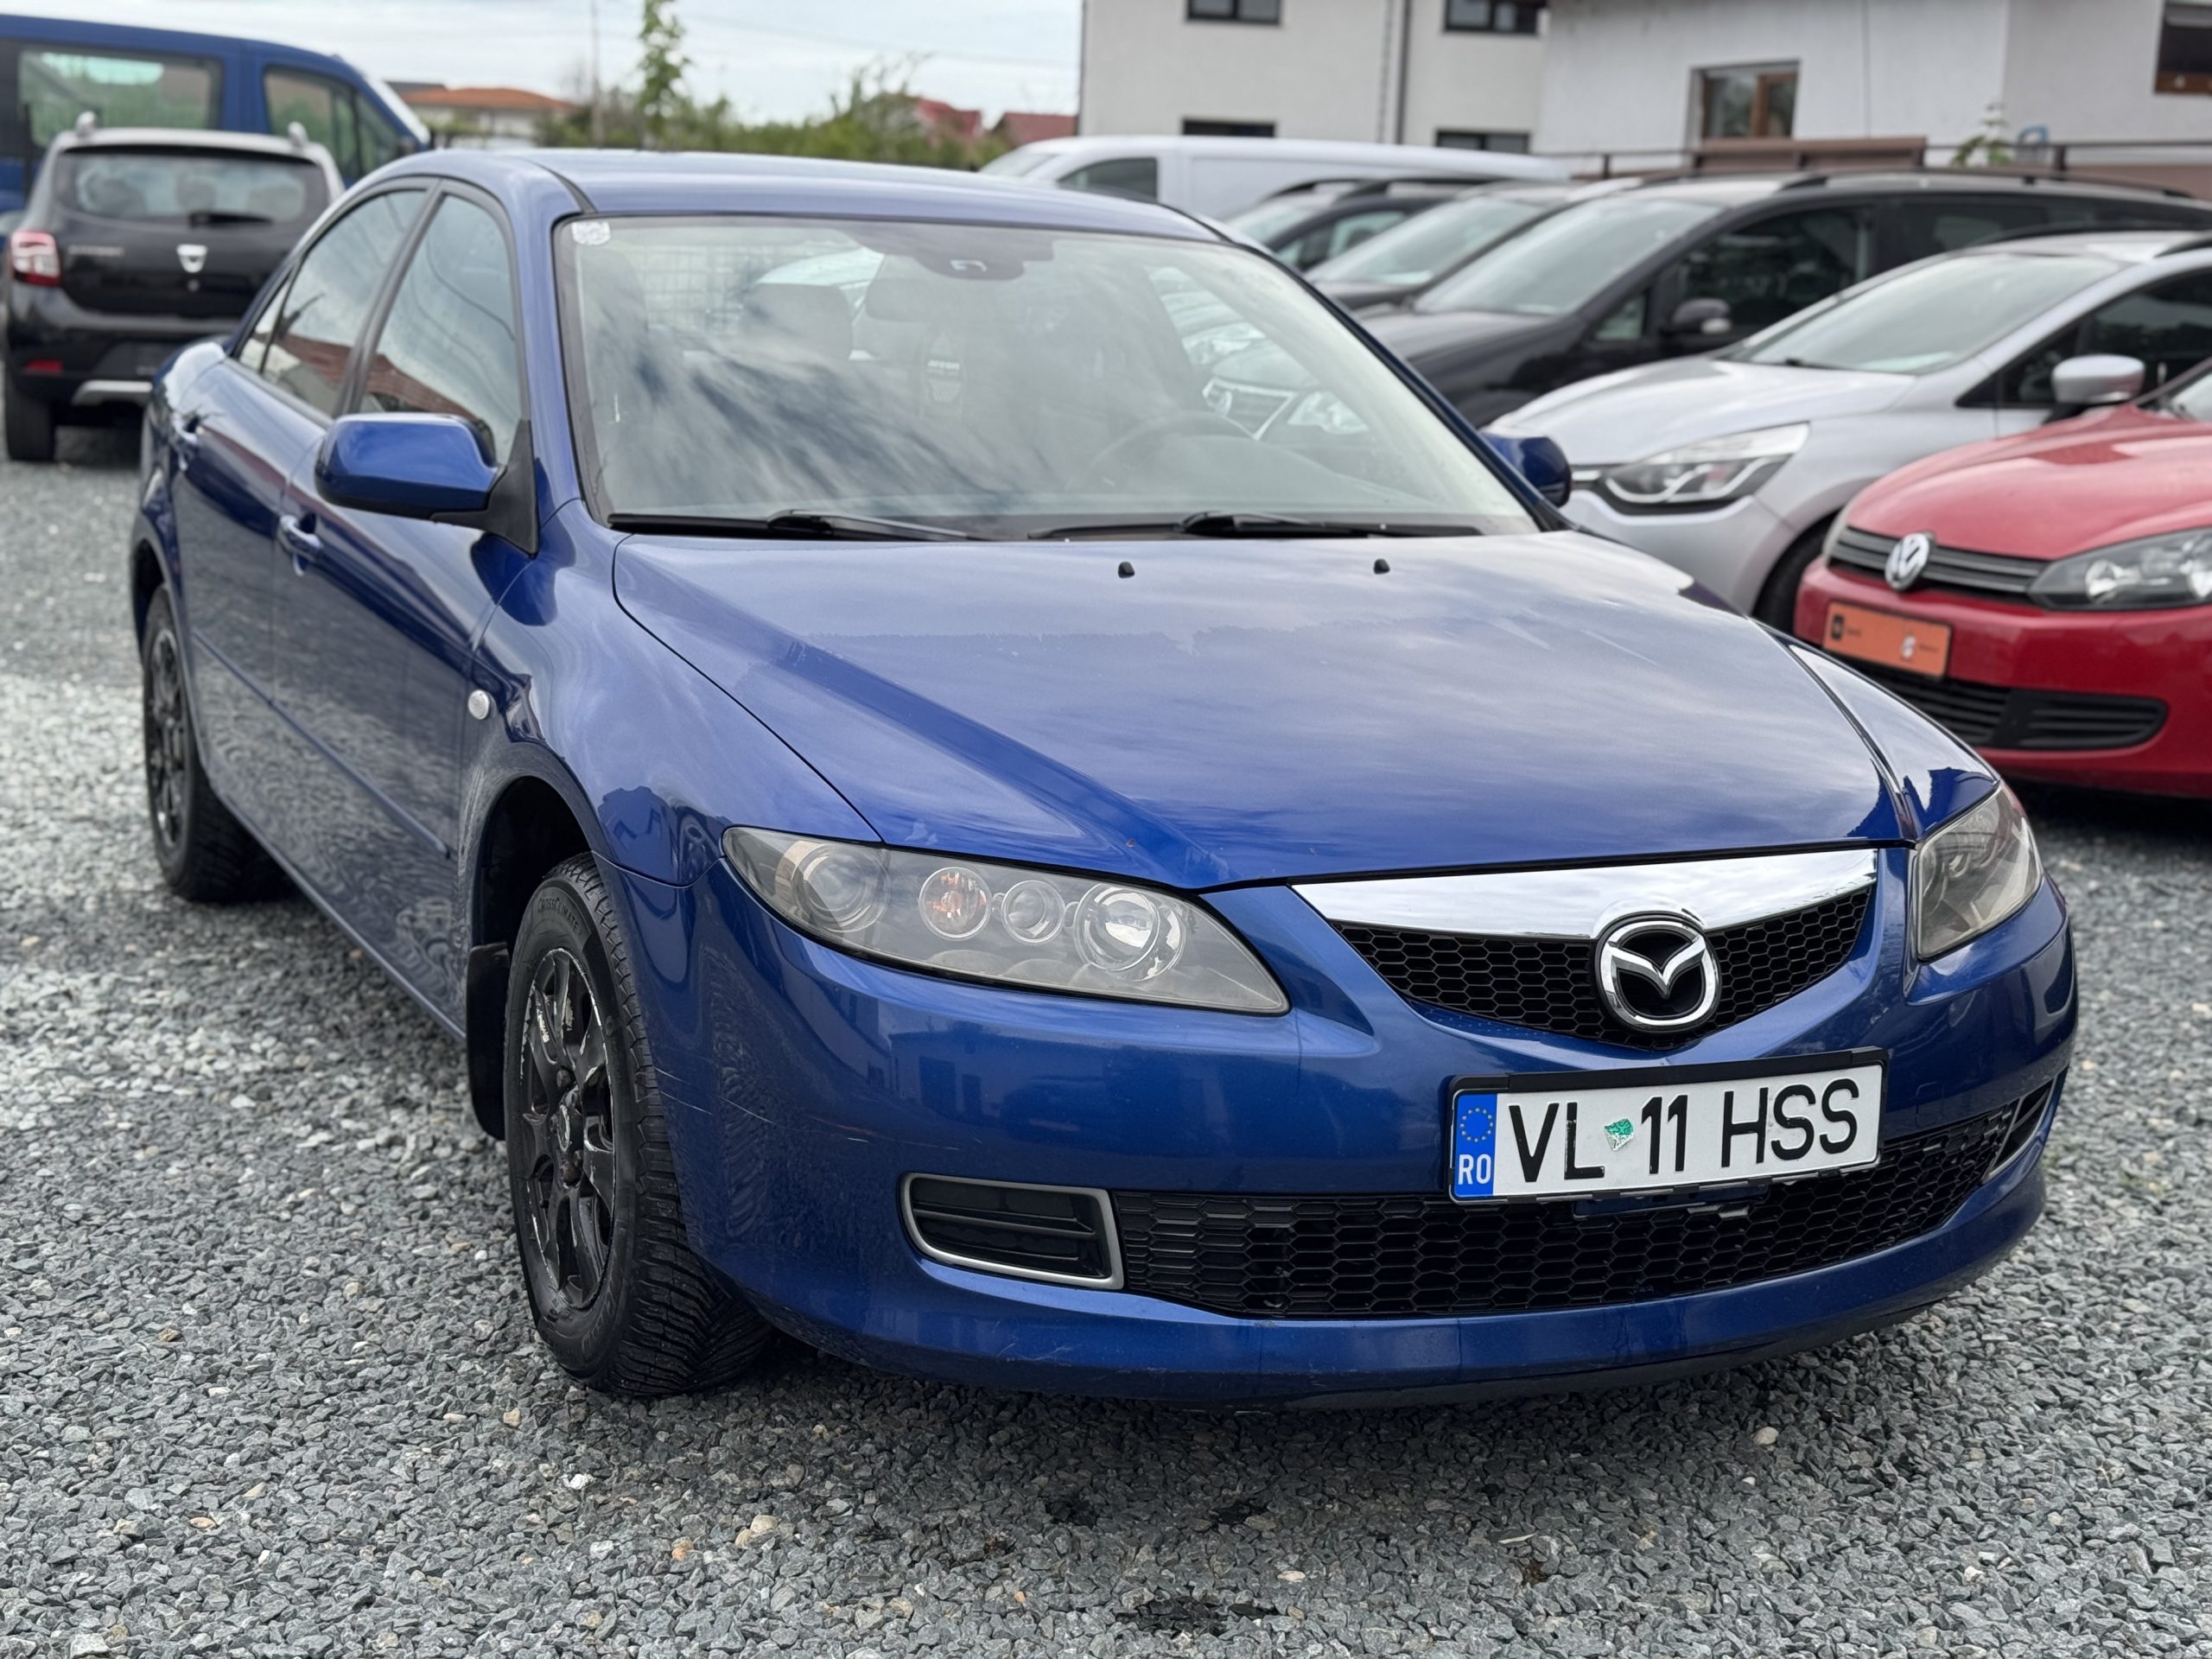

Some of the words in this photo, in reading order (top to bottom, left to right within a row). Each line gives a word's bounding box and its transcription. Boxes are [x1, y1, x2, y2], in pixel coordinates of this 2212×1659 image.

[1509, 1102, 1605, 1182] VL
[1641, 1094, 1688, 1174] 11
[1721, 1077, 1859, 1168] HSS
[1457, 1153, 1492, 1185] RO
